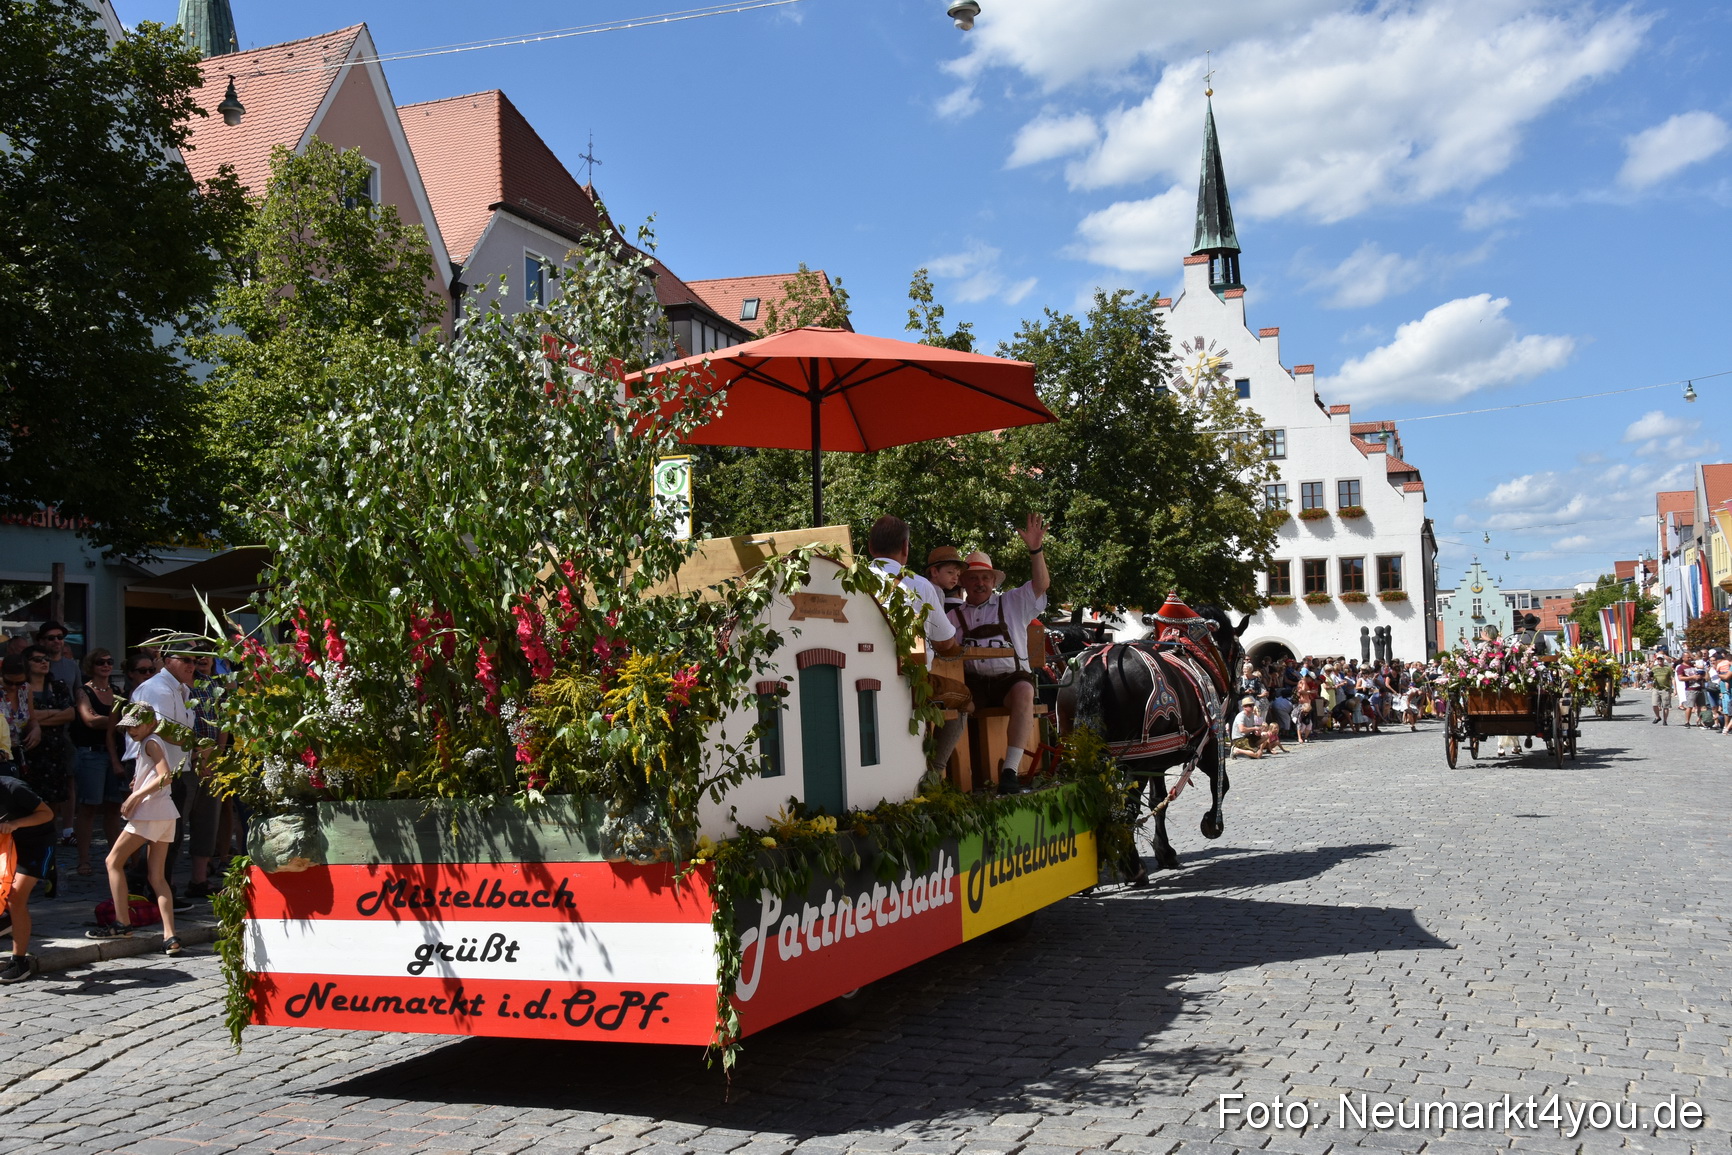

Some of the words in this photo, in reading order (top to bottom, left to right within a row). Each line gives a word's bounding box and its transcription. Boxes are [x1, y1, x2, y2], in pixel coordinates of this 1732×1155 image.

[968, 809, 1078, 914] Mistelbach
[356, 878, 577, 916] Mistelbach
[735, 849, 955, 1001] Partnerstadt
[407, 932, 521, 975] grüßt
[285, 982, 485, 1019] Neumarkt
